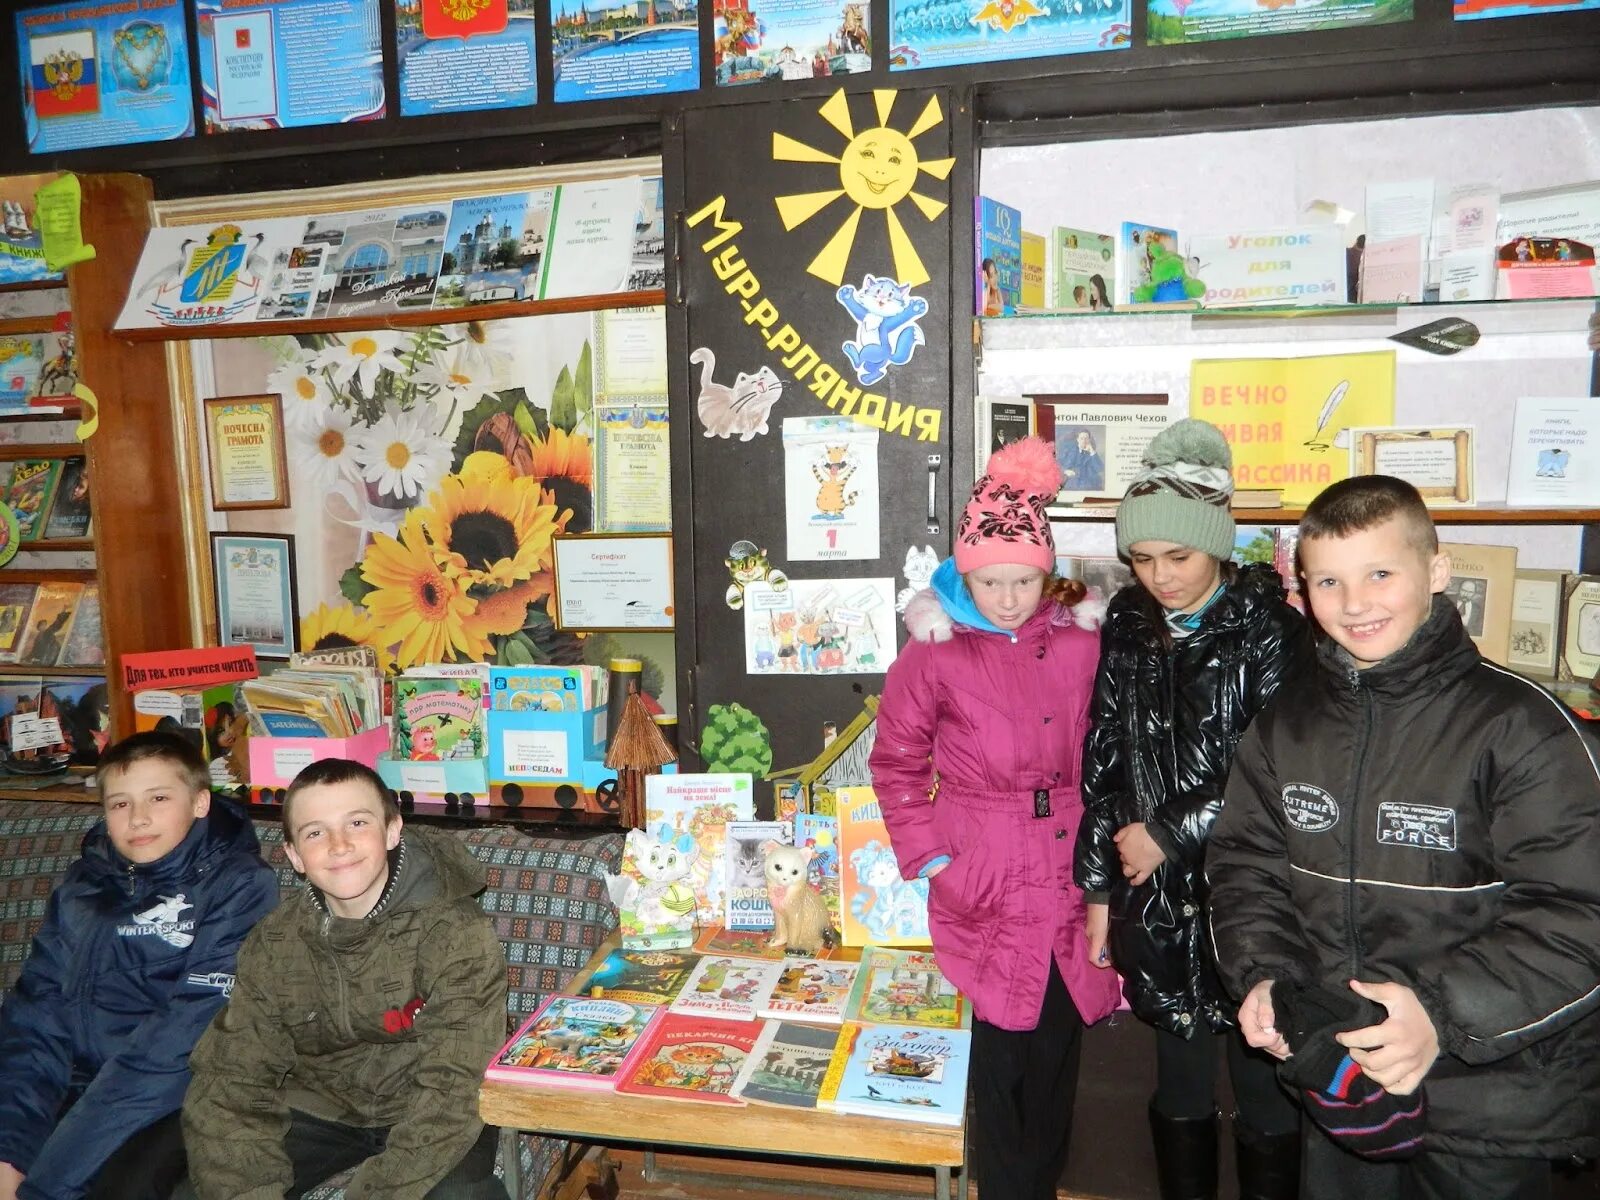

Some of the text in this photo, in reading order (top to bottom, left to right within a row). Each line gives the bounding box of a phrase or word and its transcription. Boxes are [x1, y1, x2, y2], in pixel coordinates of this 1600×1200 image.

[995, 206, 1013, 238] IQ
[1227, 233, 1312, 249] Уголок
[9, 245, 46, 258] КНИЖ
[1248, 260, 1292, 274] для
[1204, 280, 1336, 301] родителей
[1202, 385, 1287, 407] ВЕЧНО
[1054, 413, 1168, 424] нтон Павлович Чехов
[223, 423, 265, 435] ПОЧЕСНА
[1215, 422, 1284, 443] ИВАЯ
[227, 435, 264, 447] ГРАМОТА
[1230, 463, 1332, 484] АССИКА
[826, 529, 837, 549] 1
[591, 553, 627, 561] Сертифікат
[817, 550, 848, 559] марта
[125, 658, 255, 688] Для тех, кто учится читать
[409, 699, 473, 715] про математику
[508, 764, 563, 775] НЕПОСЕДАМ
[852, 802, 881, 821] КИЦ
[1382, 829, 1450, 847] FORCE
[731, 888, 768, 898] ЗДОРО
[731, 899, 772, 911] КОШК
[117, 920, 196, 936] WINTER SPORT
[666, 1031, 737, 1042] ПЕКАРЧИК
